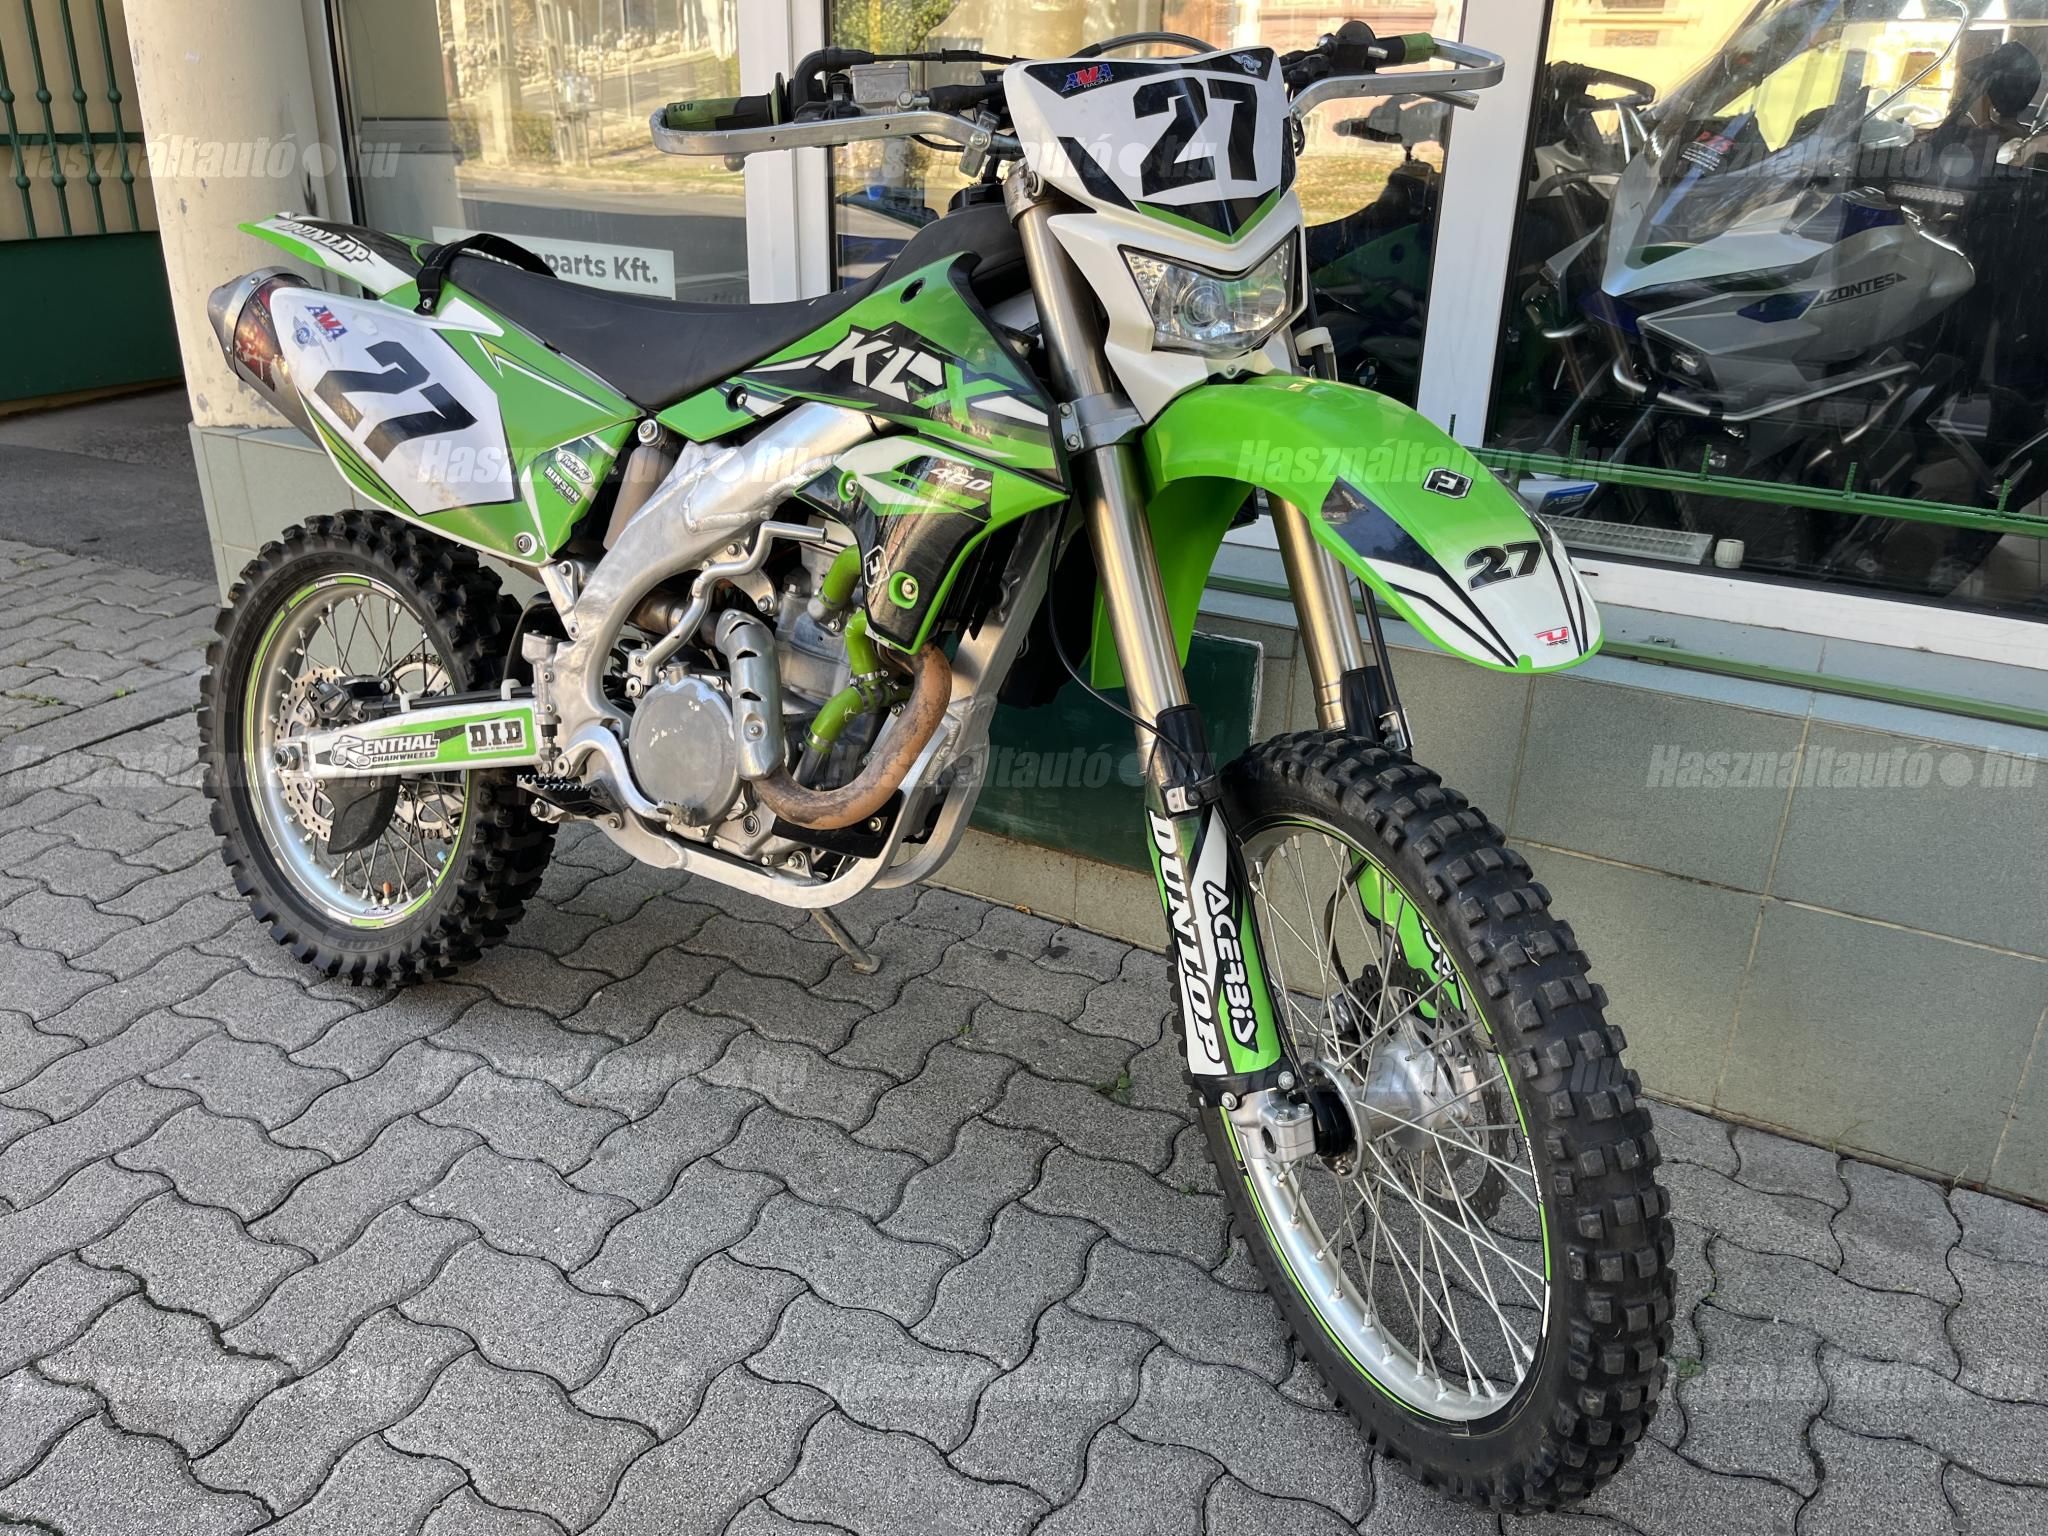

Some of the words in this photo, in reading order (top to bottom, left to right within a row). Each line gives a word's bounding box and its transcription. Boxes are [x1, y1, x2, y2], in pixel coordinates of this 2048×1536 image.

[1061, 63, 1114, 93] AMA
[1133, 77, 1258, 197] 27
[280, 220, 372, 262] DUNLOP
[613, 256, 658, 284] Kft.
[1825, 272, 1896, 302] ZONTES
[304, 305, 348, 341] AMA
[314, 341, 478, 463] 27
[544, 465, 581, 502] HINSON
[1464, 541, 1543, 591] 27
[469, 720, 523, 748] D.I.D
[371, 750, 437, 764] CHAINWHEELS
[1149, 809, 1222, 1063] DUNLOP
[1204, 881, 1257, 1044] ACERBIS
